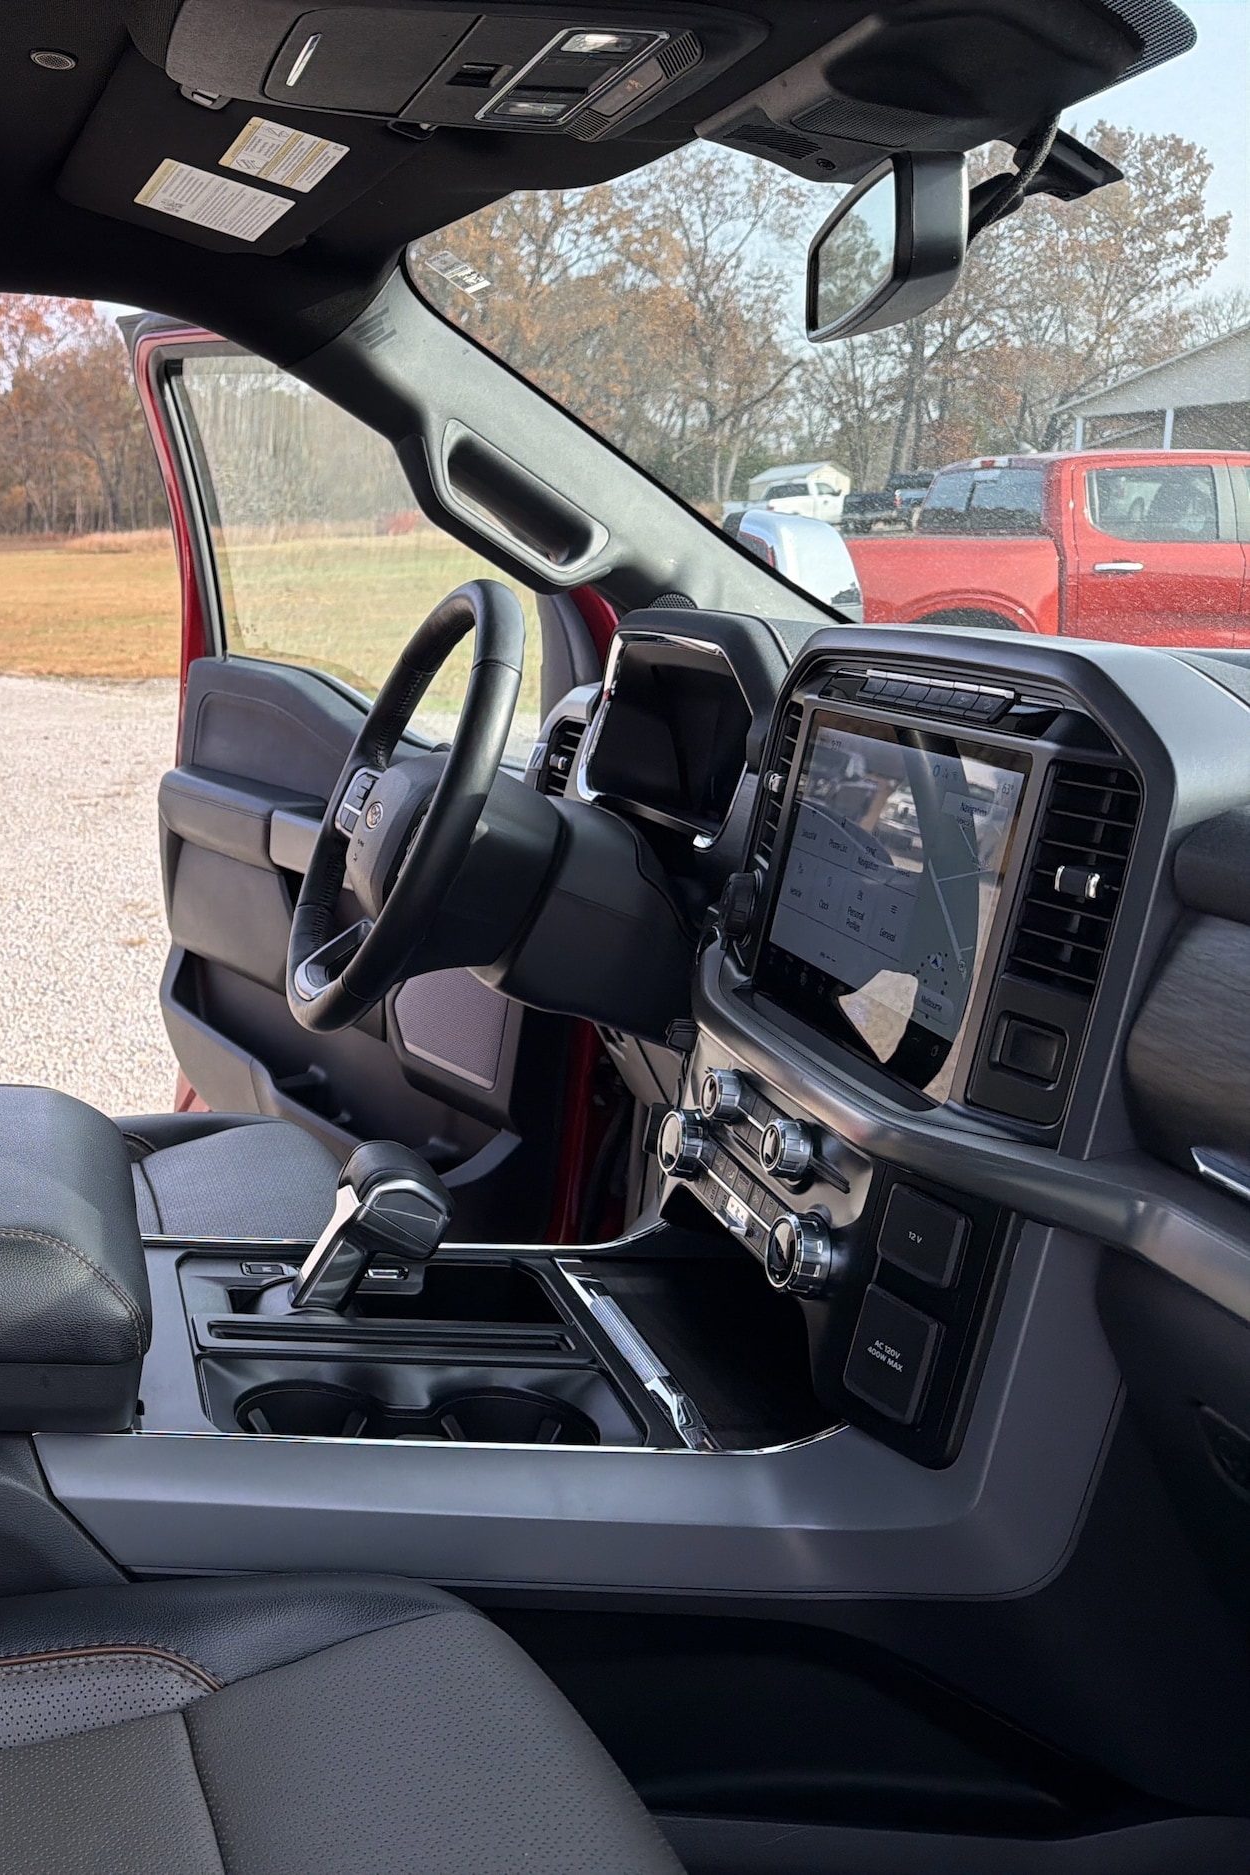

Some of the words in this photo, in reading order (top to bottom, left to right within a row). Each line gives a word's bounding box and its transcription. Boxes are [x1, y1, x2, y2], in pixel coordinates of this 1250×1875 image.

[879, 927, 896, 942] General
[867, 1346, 887, 1361] 400W
[887, 1358, 903, 1372] MAX
[874, 1340, 884, 1350] AC
[884, 1345, 901, 1359] 120V
